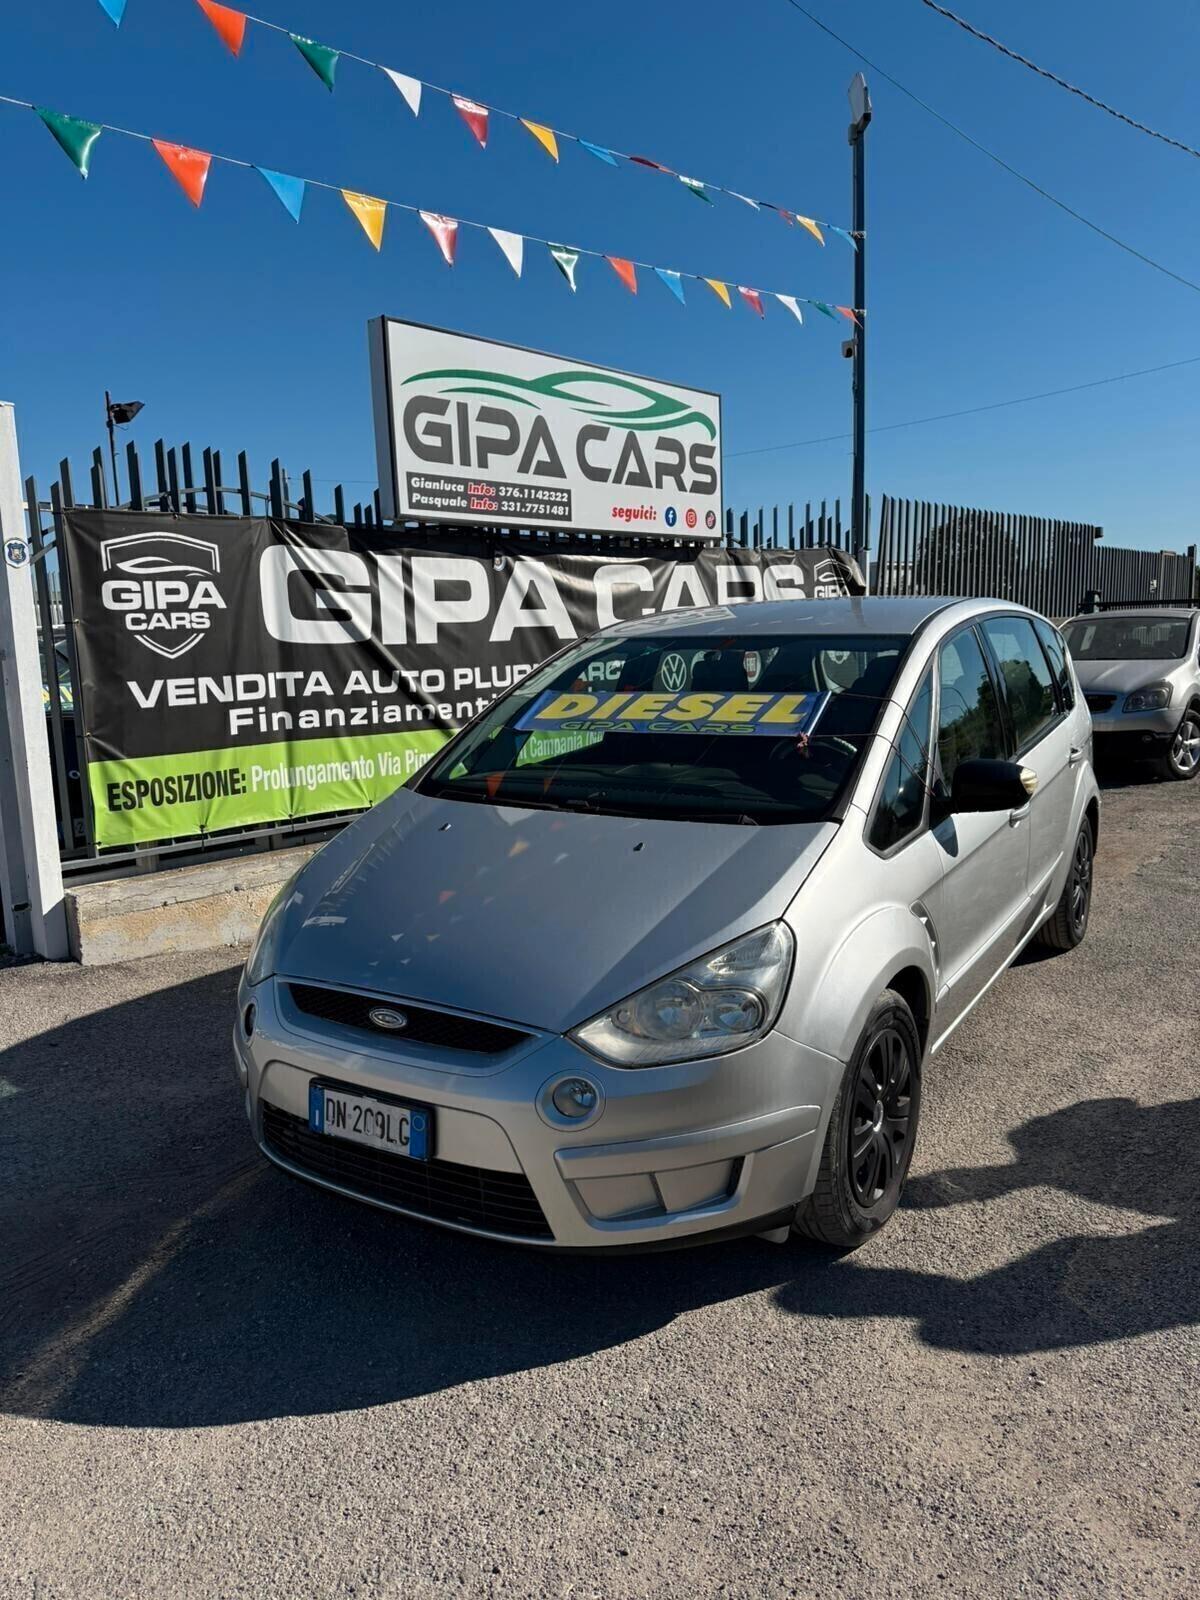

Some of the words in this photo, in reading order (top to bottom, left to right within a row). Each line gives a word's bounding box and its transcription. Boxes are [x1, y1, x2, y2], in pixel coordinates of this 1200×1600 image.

[403, 395, 567, 479] GIPA
[576, 424, 718, 495] CARS
[411, 477, 465, 494] Gianluca
[467, 482, 496, 496] Info:
[498, 486, 568, 502] 376.1142322
[412, 493, 467, 509] Pasquale
[470, 498, 498, 511] Info:
[501, 500, 570, 516] 331.7751481
[611, 505, 657, 522] seguici:
[101, 579, 227, 611] GIPA
[259, 544, 579, 645] GIPA
[125, 611, 211, 631] CARS
[127, 671, 334, 709] VENDITA
[344, 669, 446, 695] AUTO
[535, 693, 810, 724] DIESEL
[559, 720, 635, 732] GIPA
[647, 721, 756, 734] CARS
[107, 767, 247, 812] ESPOSIZIONE:
[250, 753, 375, 793] Prolungamento
[377, 752, 401, 776] Via
